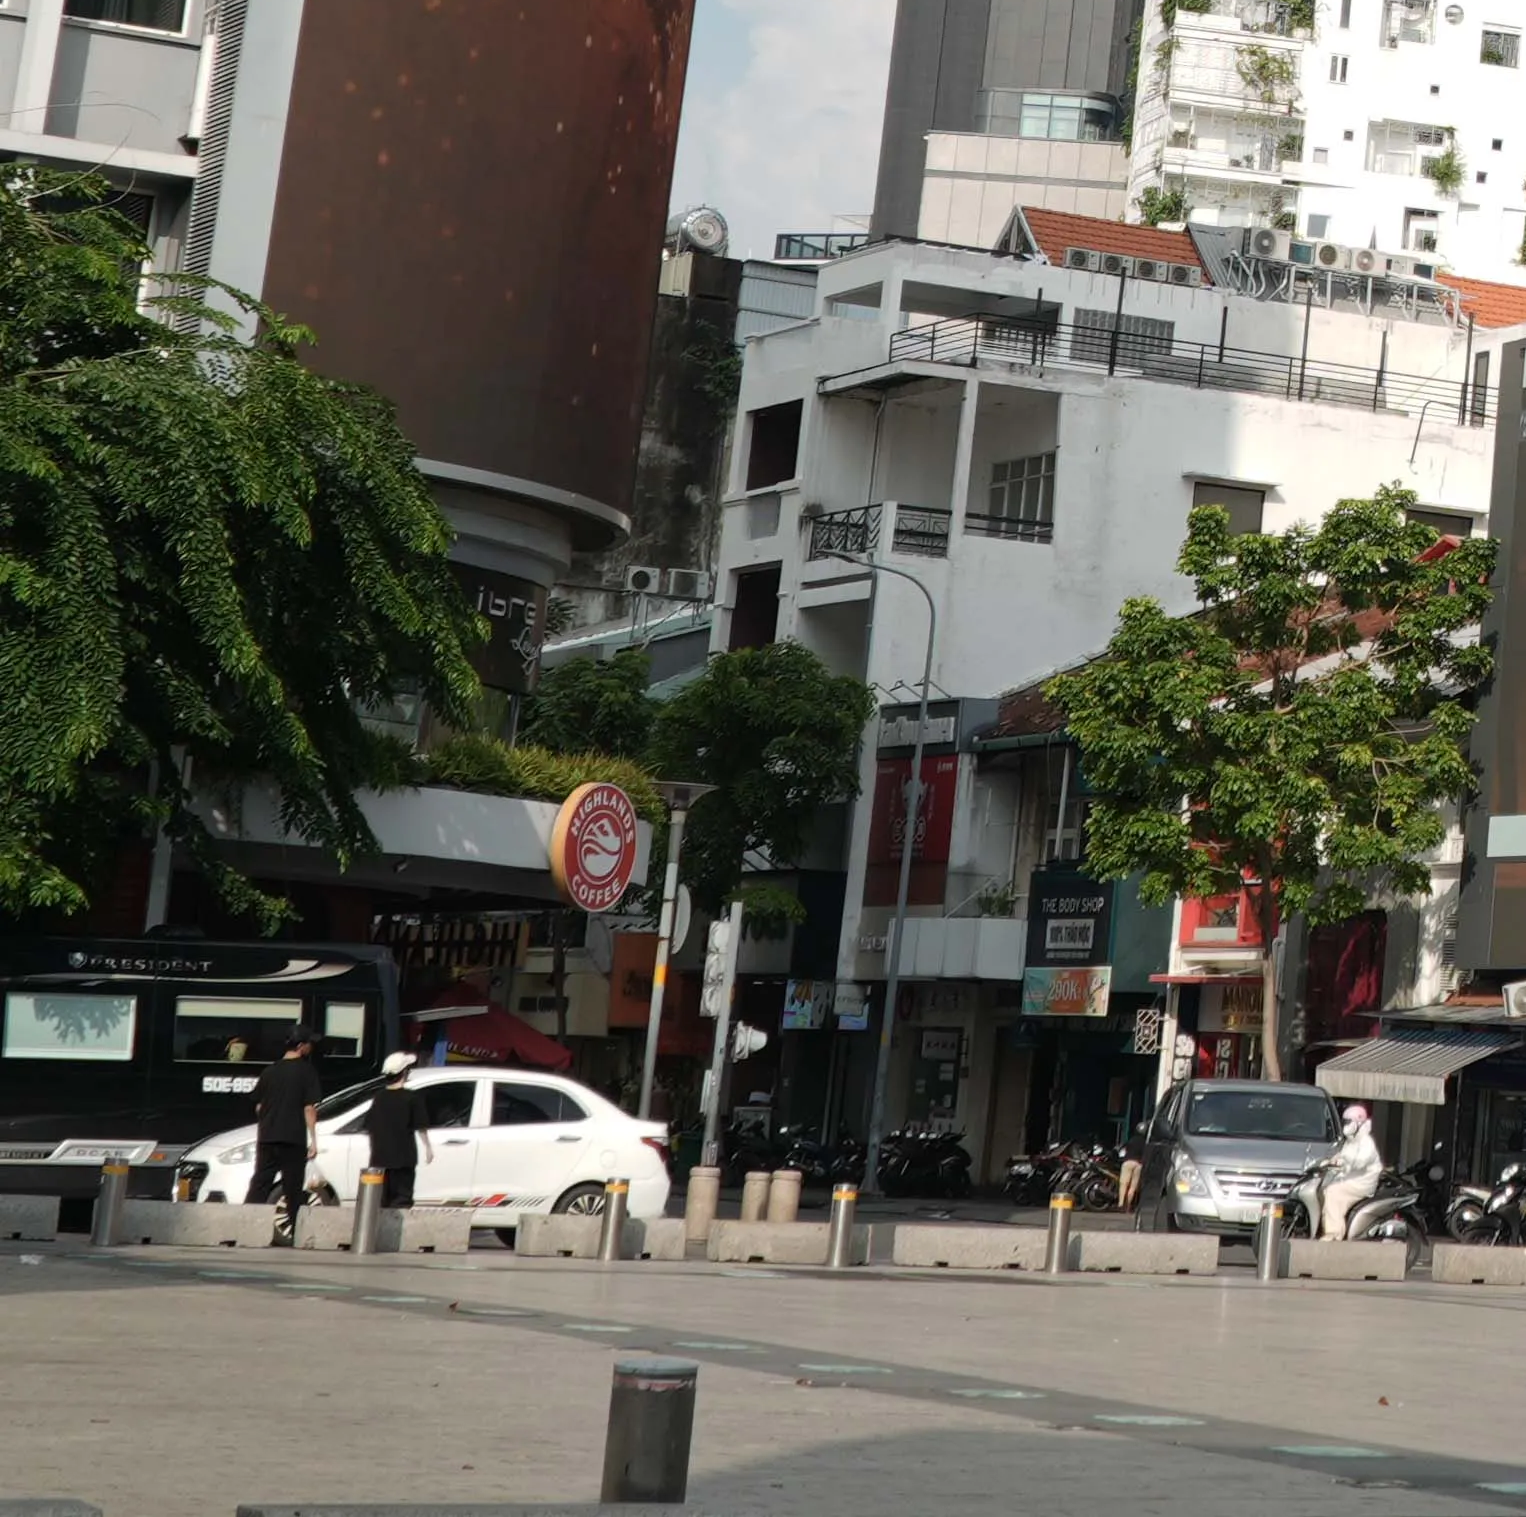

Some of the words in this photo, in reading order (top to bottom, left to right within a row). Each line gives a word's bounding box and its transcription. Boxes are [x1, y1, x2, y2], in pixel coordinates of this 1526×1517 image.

[571, 790, 634, 844] HIGHLANDS
[572, 875, 621, 905] COFFEE
[1042, 898, 1057, 913] THE
[1058, 898, 1080, 914] BODY
[1081, 897, 1104, 913] SHOP
[90, 957, 213, 972] PRESIDENT
